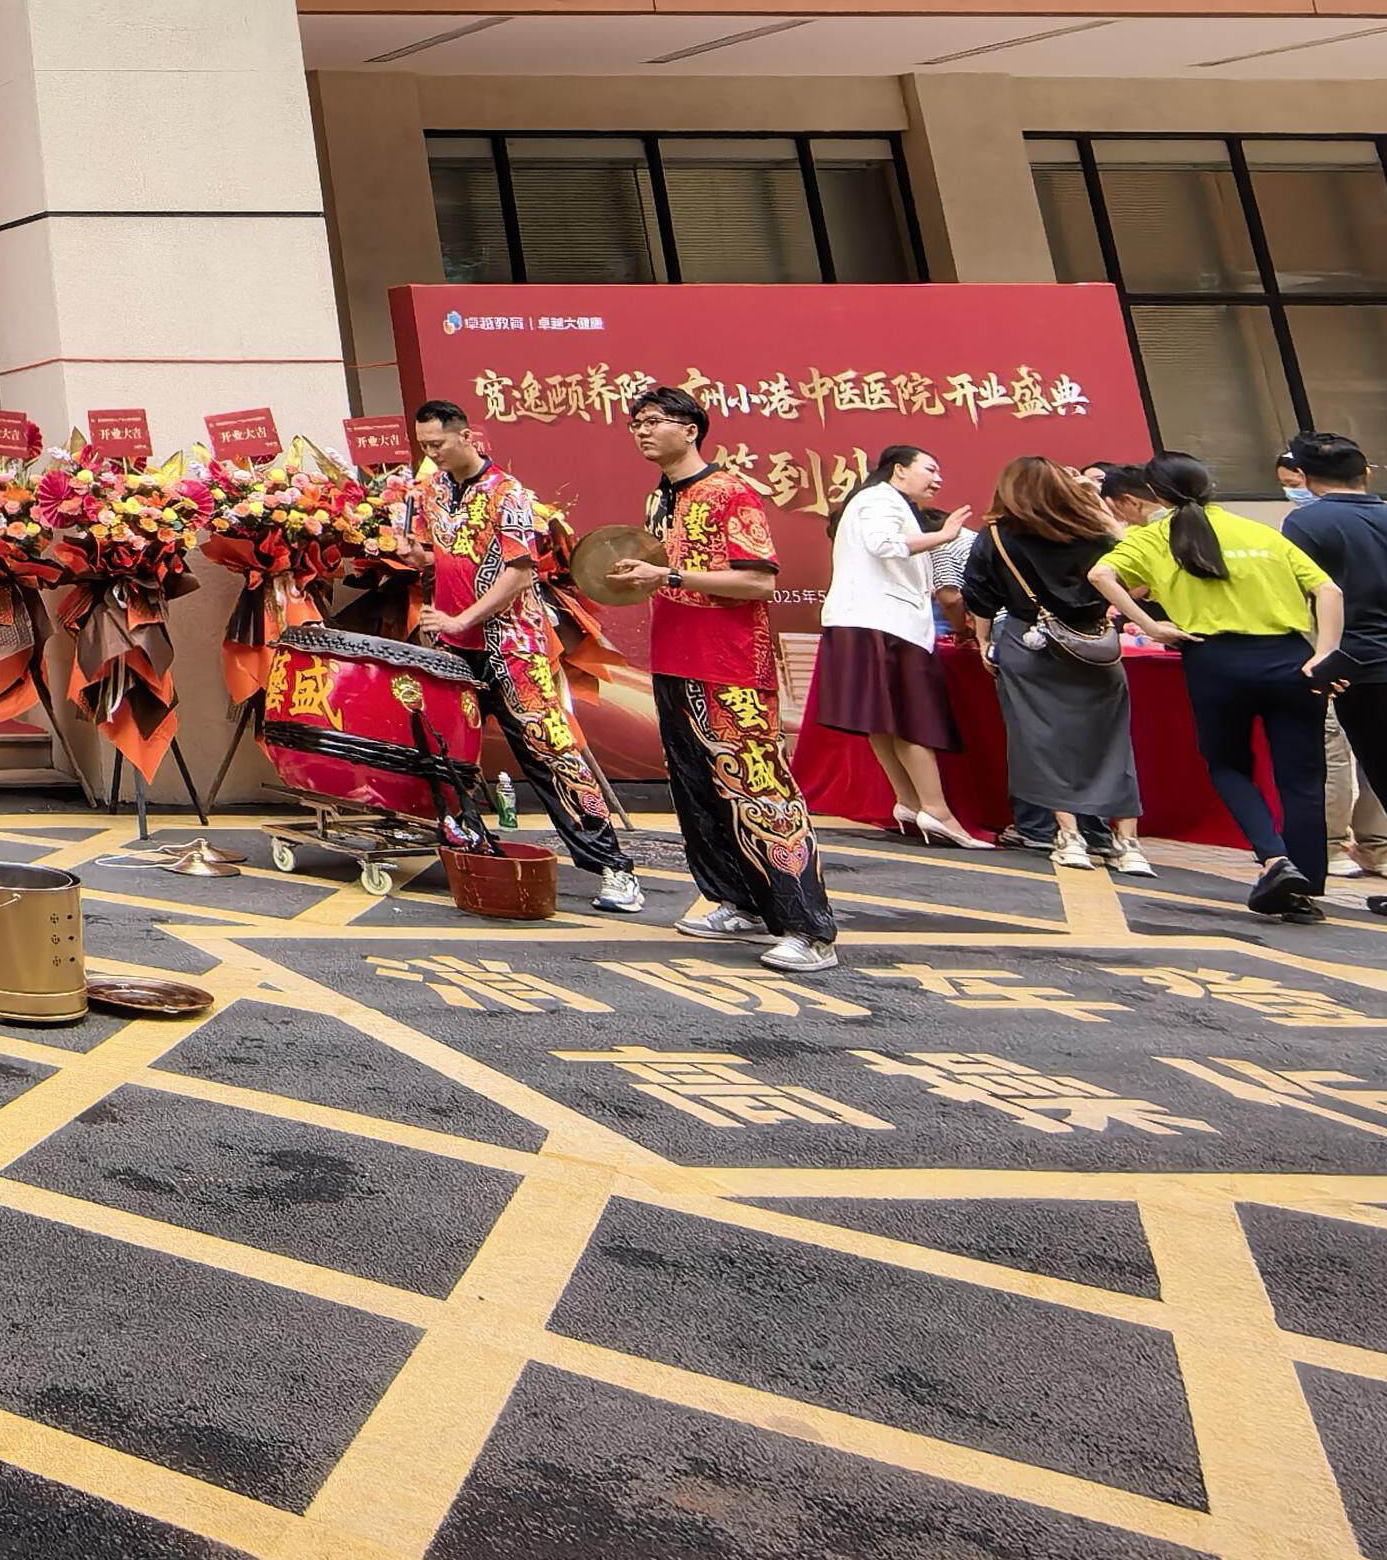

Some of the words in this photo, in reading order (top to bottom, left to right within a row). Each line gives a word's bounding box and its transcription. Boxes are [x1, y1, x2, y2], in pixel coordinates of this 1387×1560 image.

[99, 427, 142, 441] 开业大吉
[220, 424, 268, 442] 开业大吉
[357, 432, 401, 449] 开业大吉
[767, 589, 827, 604] 025年5
